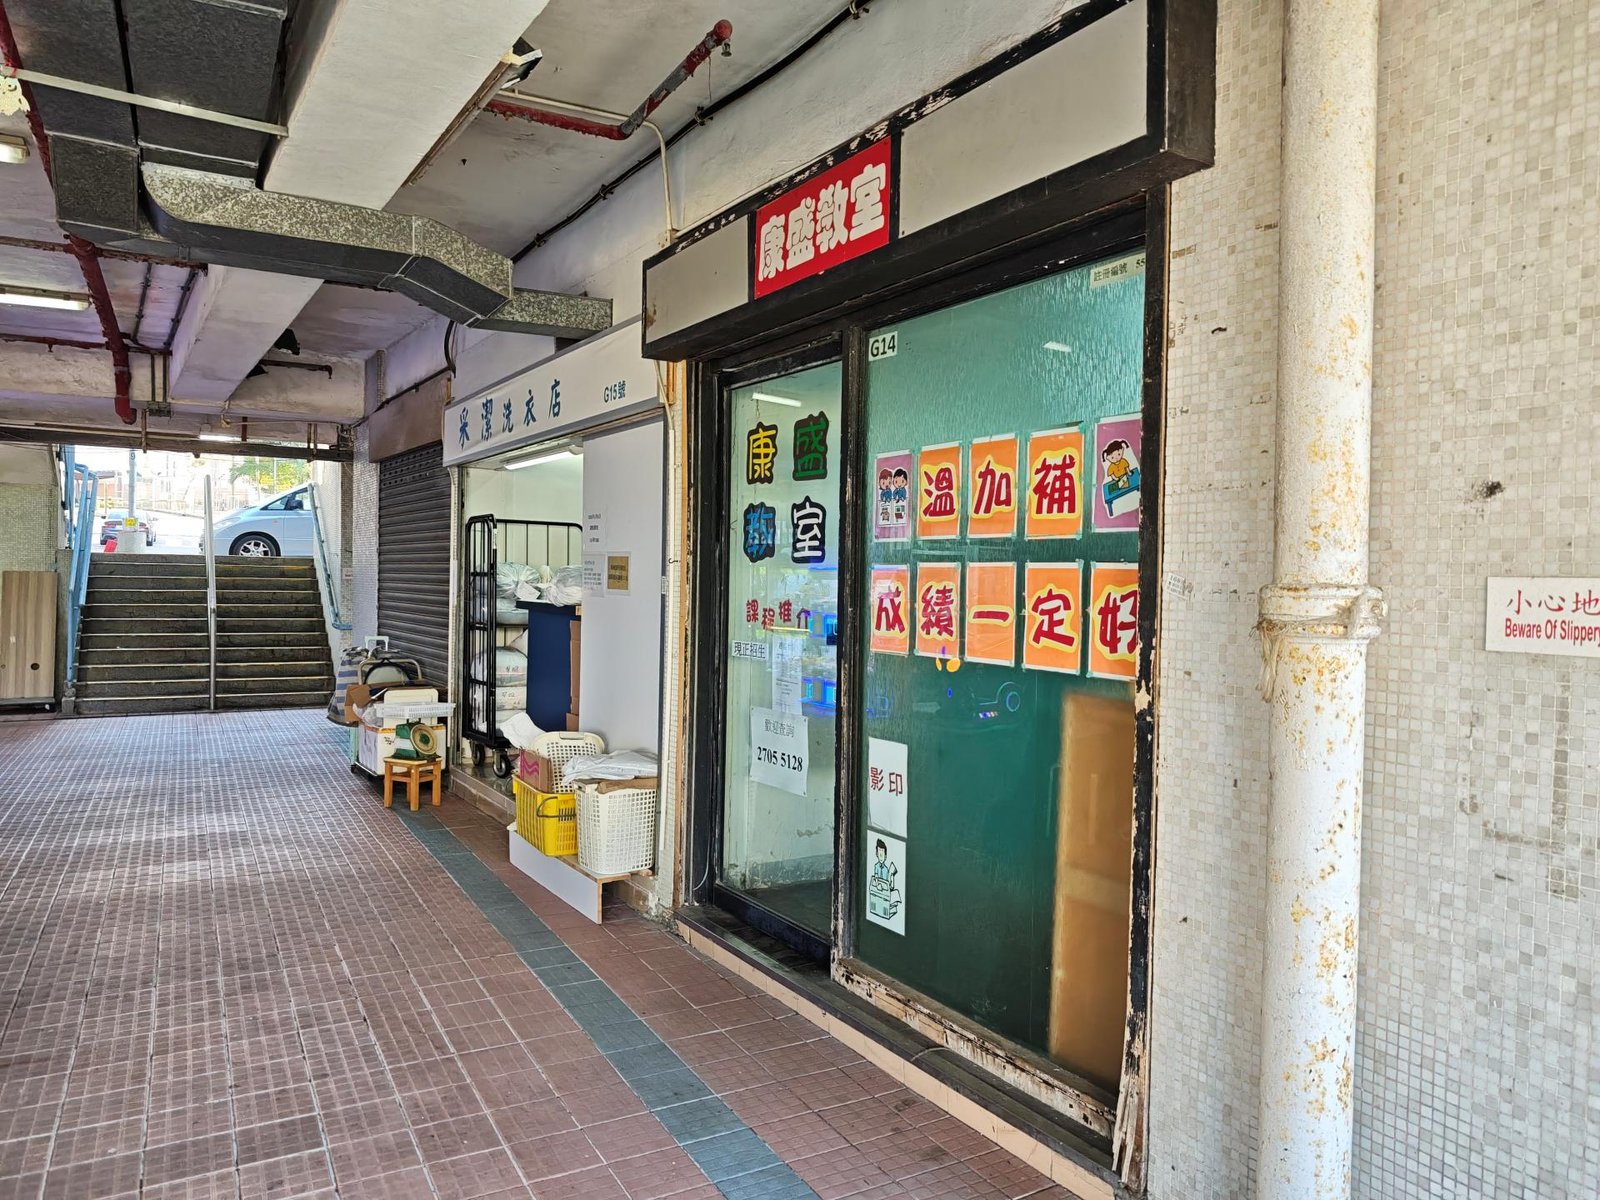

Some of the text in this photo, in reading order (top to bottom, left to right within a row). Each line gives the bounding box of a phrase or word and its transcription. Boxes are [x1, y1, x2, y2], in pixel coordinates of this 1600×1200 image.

[758, 163, 886, 282] 康盛教室
[870, 334, 896, 358] G14
[603, 380, 626, 403] G15號
[1506, 589, 1600, 616] 小心地
[875, 585, 1138, 654] 成績一定好
[1505, 618, 1542, 639] Beware
[1545, 619, 1558, 639] Of
[734, 641, 766, 659] 現正招生
[757, 746, 803, 773] 2705 5128
[870, 766, 904, 796] 影印
